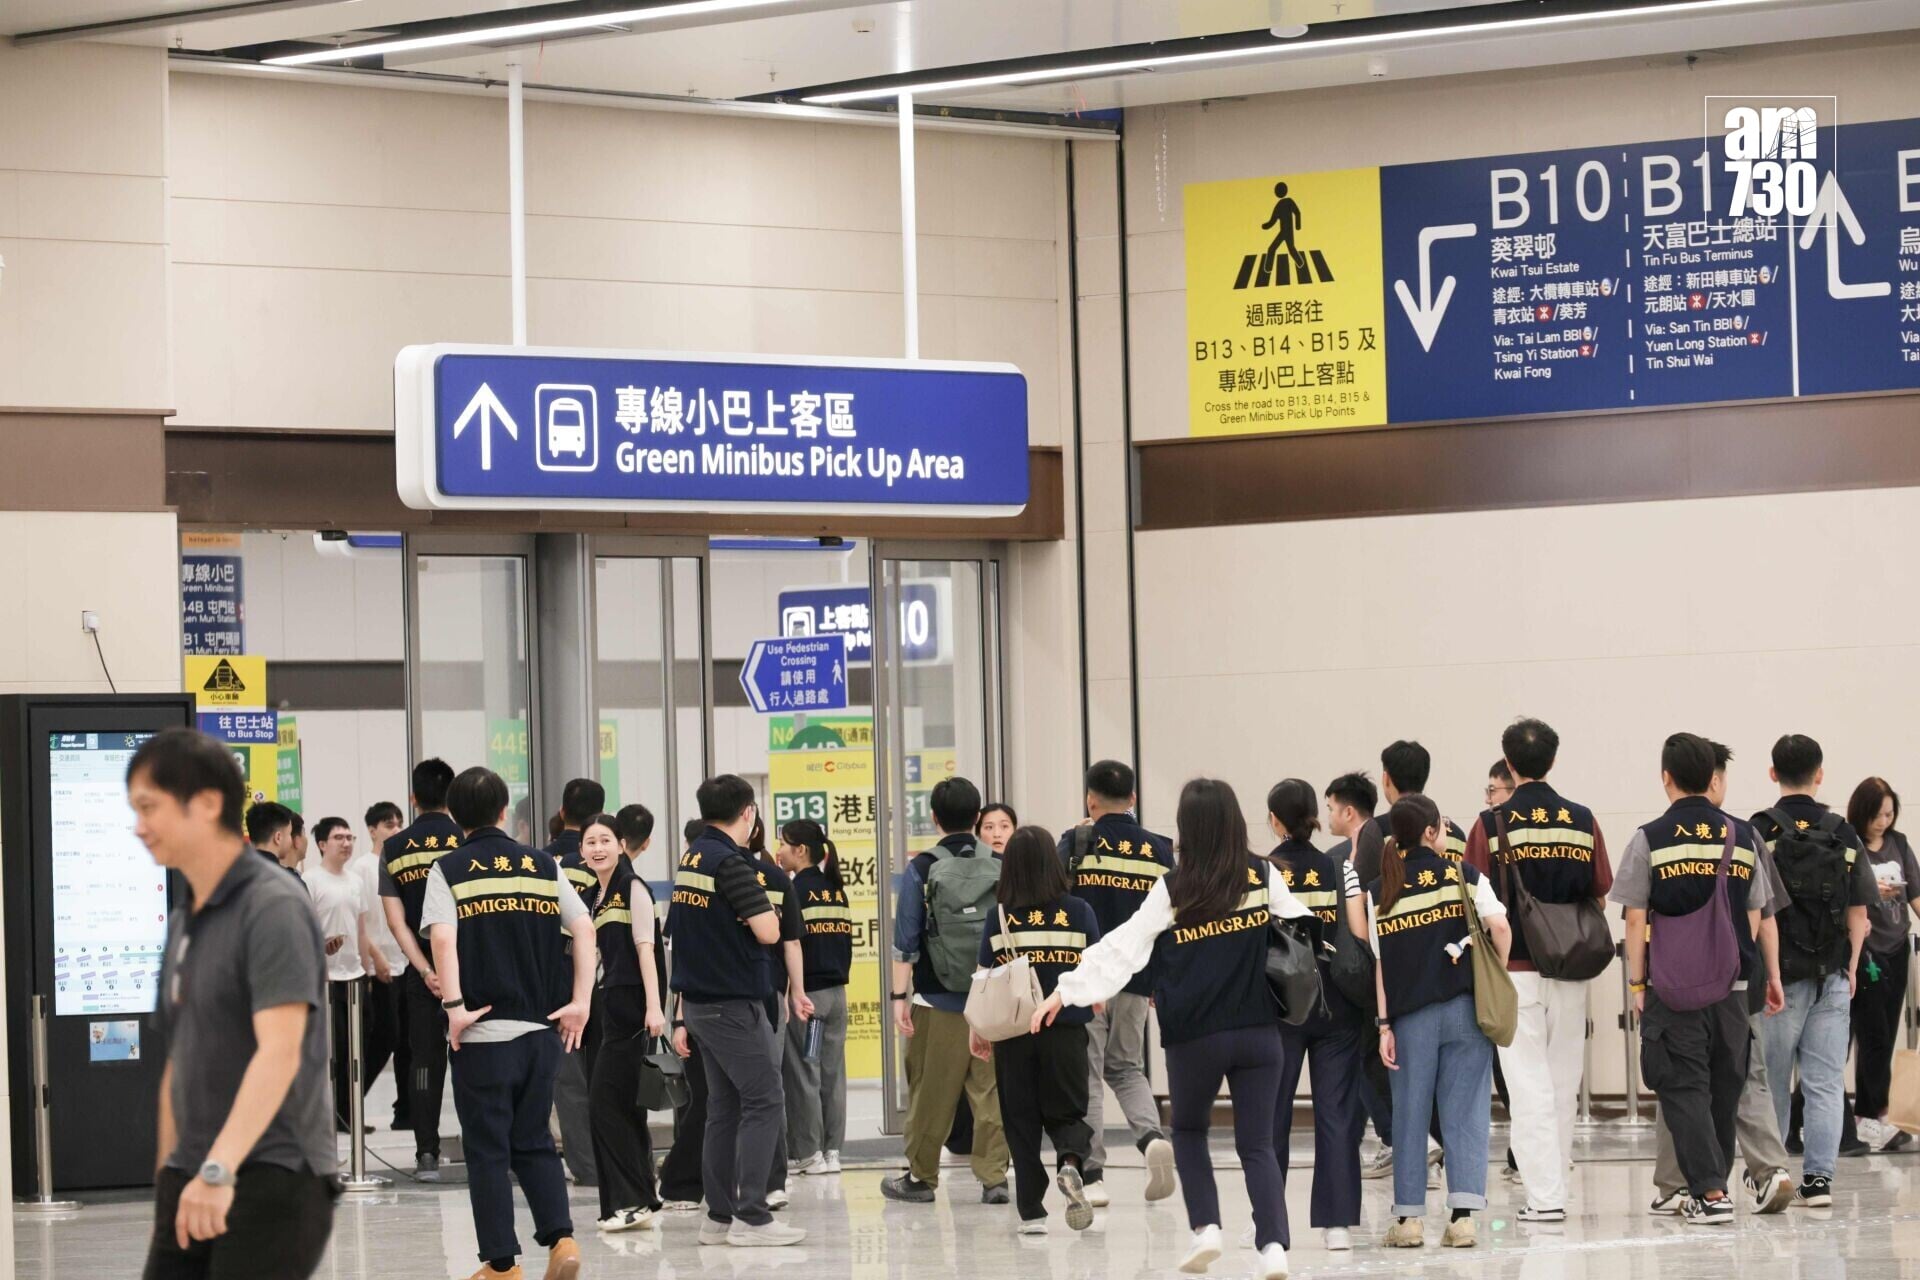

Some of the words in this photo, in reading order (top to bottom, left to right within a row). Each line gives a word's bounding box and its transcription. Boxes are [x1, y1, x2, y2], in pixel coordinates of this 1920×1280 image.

[1490, 160, 1611, 230] B10
[1491, 233, 1556, 263] 葵翠邨
[1643, 254, 1660, 266] Tin
[1663, 253, 1678, 265] Fu
[1680, 252, 1701, 264] Bus
[1703, 249, 1754, 262] Terminus
[1899, 259, 1918, 272] Wu
[1491, 266, 1518, 279] Kwai
[1520, 264, 1543, 276] Tsui
[1546, 262, 1580, 274] Estate
[1246, 299, 1324, 328] 過馬路往
[1645, 323, 1666, 336] Via:
[1669, 321, 1690, 334] San
[1693, 320, 1711, 332] Tin
[1357, 327, 1376, 351] 及
[1494, 334, 1514, 347] Via:
[1517, 332, 1534, 345] Tai
[1536, 331, 1561, 344] Lam
[1646, 339, 1673, 352] Yuen
[1676, 337, 1705, 351] Long
[1708, 334, 1747, 347] Station
[1494, 351, 1523, 364] Tsing
[1526, 349, 1537, 361] Yi
[1540, 347, 1579, 360] Station
[1646, 356, 1664, 369] Tin
[1667, 354, 1690, 367] Shui
[1693, 353, 1714, 366] Wai
[1218, 360, 1355, 393] 專線小巴上客點
[1494, 367, 1521, 380] Kwai
[1524, 366, 1552, 378] Fong
[1204, 401, 1231, 413] Cross
[1234, 399, 1249, 411] the
[1251, 398, 1272, 410] road
[1275, 398, 1285, 408] to
[1340, 392, 1359, 403] B15
[1363, 391, 1370, 401] &
[615, 384, 857, 438] 專線小巴上客區
[1219, 413, 1246, 424] Green
[1249, 410, 1284, 423] Minibus
[1288, 408, 1307, 420] Pick
[1310, 407, 1323, 419] Up
[1325, 406, 1356, 418] Points
[616, 441, 695, 475] Green
[701, 444, 804, 478] Minibus
[810, 446, 861, 478] Pick
[867, 449, 902, 487] Up
[907, 452, 965, 480] Area
[767, 644, 784, 656] Use
[786, 641, 830, 654] Pedestrian
[780, 655, 817, 667] Crossing
[781, 669, 816, 685] 請使用
[769, 690, 830, 707] 行人過路處
[218, 715, 232, 729] 往
[235, 715, 274, 729] 巴士站
[227, 730, 236, 738] to
[237, 730, 253, 738] Bus
[254, 730, 274, 740] Stop
[776, 795, 825, 821] B13
[1508, 807, 1573, 824] 入境處
[833, 828, 851, 836] Hong
[853, 827, 872, 835] Kong
[405, 834, 459, 849] 入境處
[1097, 837, 1154, 858] 入境處
[468, 854, 538, 873] 入境處
[1006, 909, 1070, 927] 入境處
